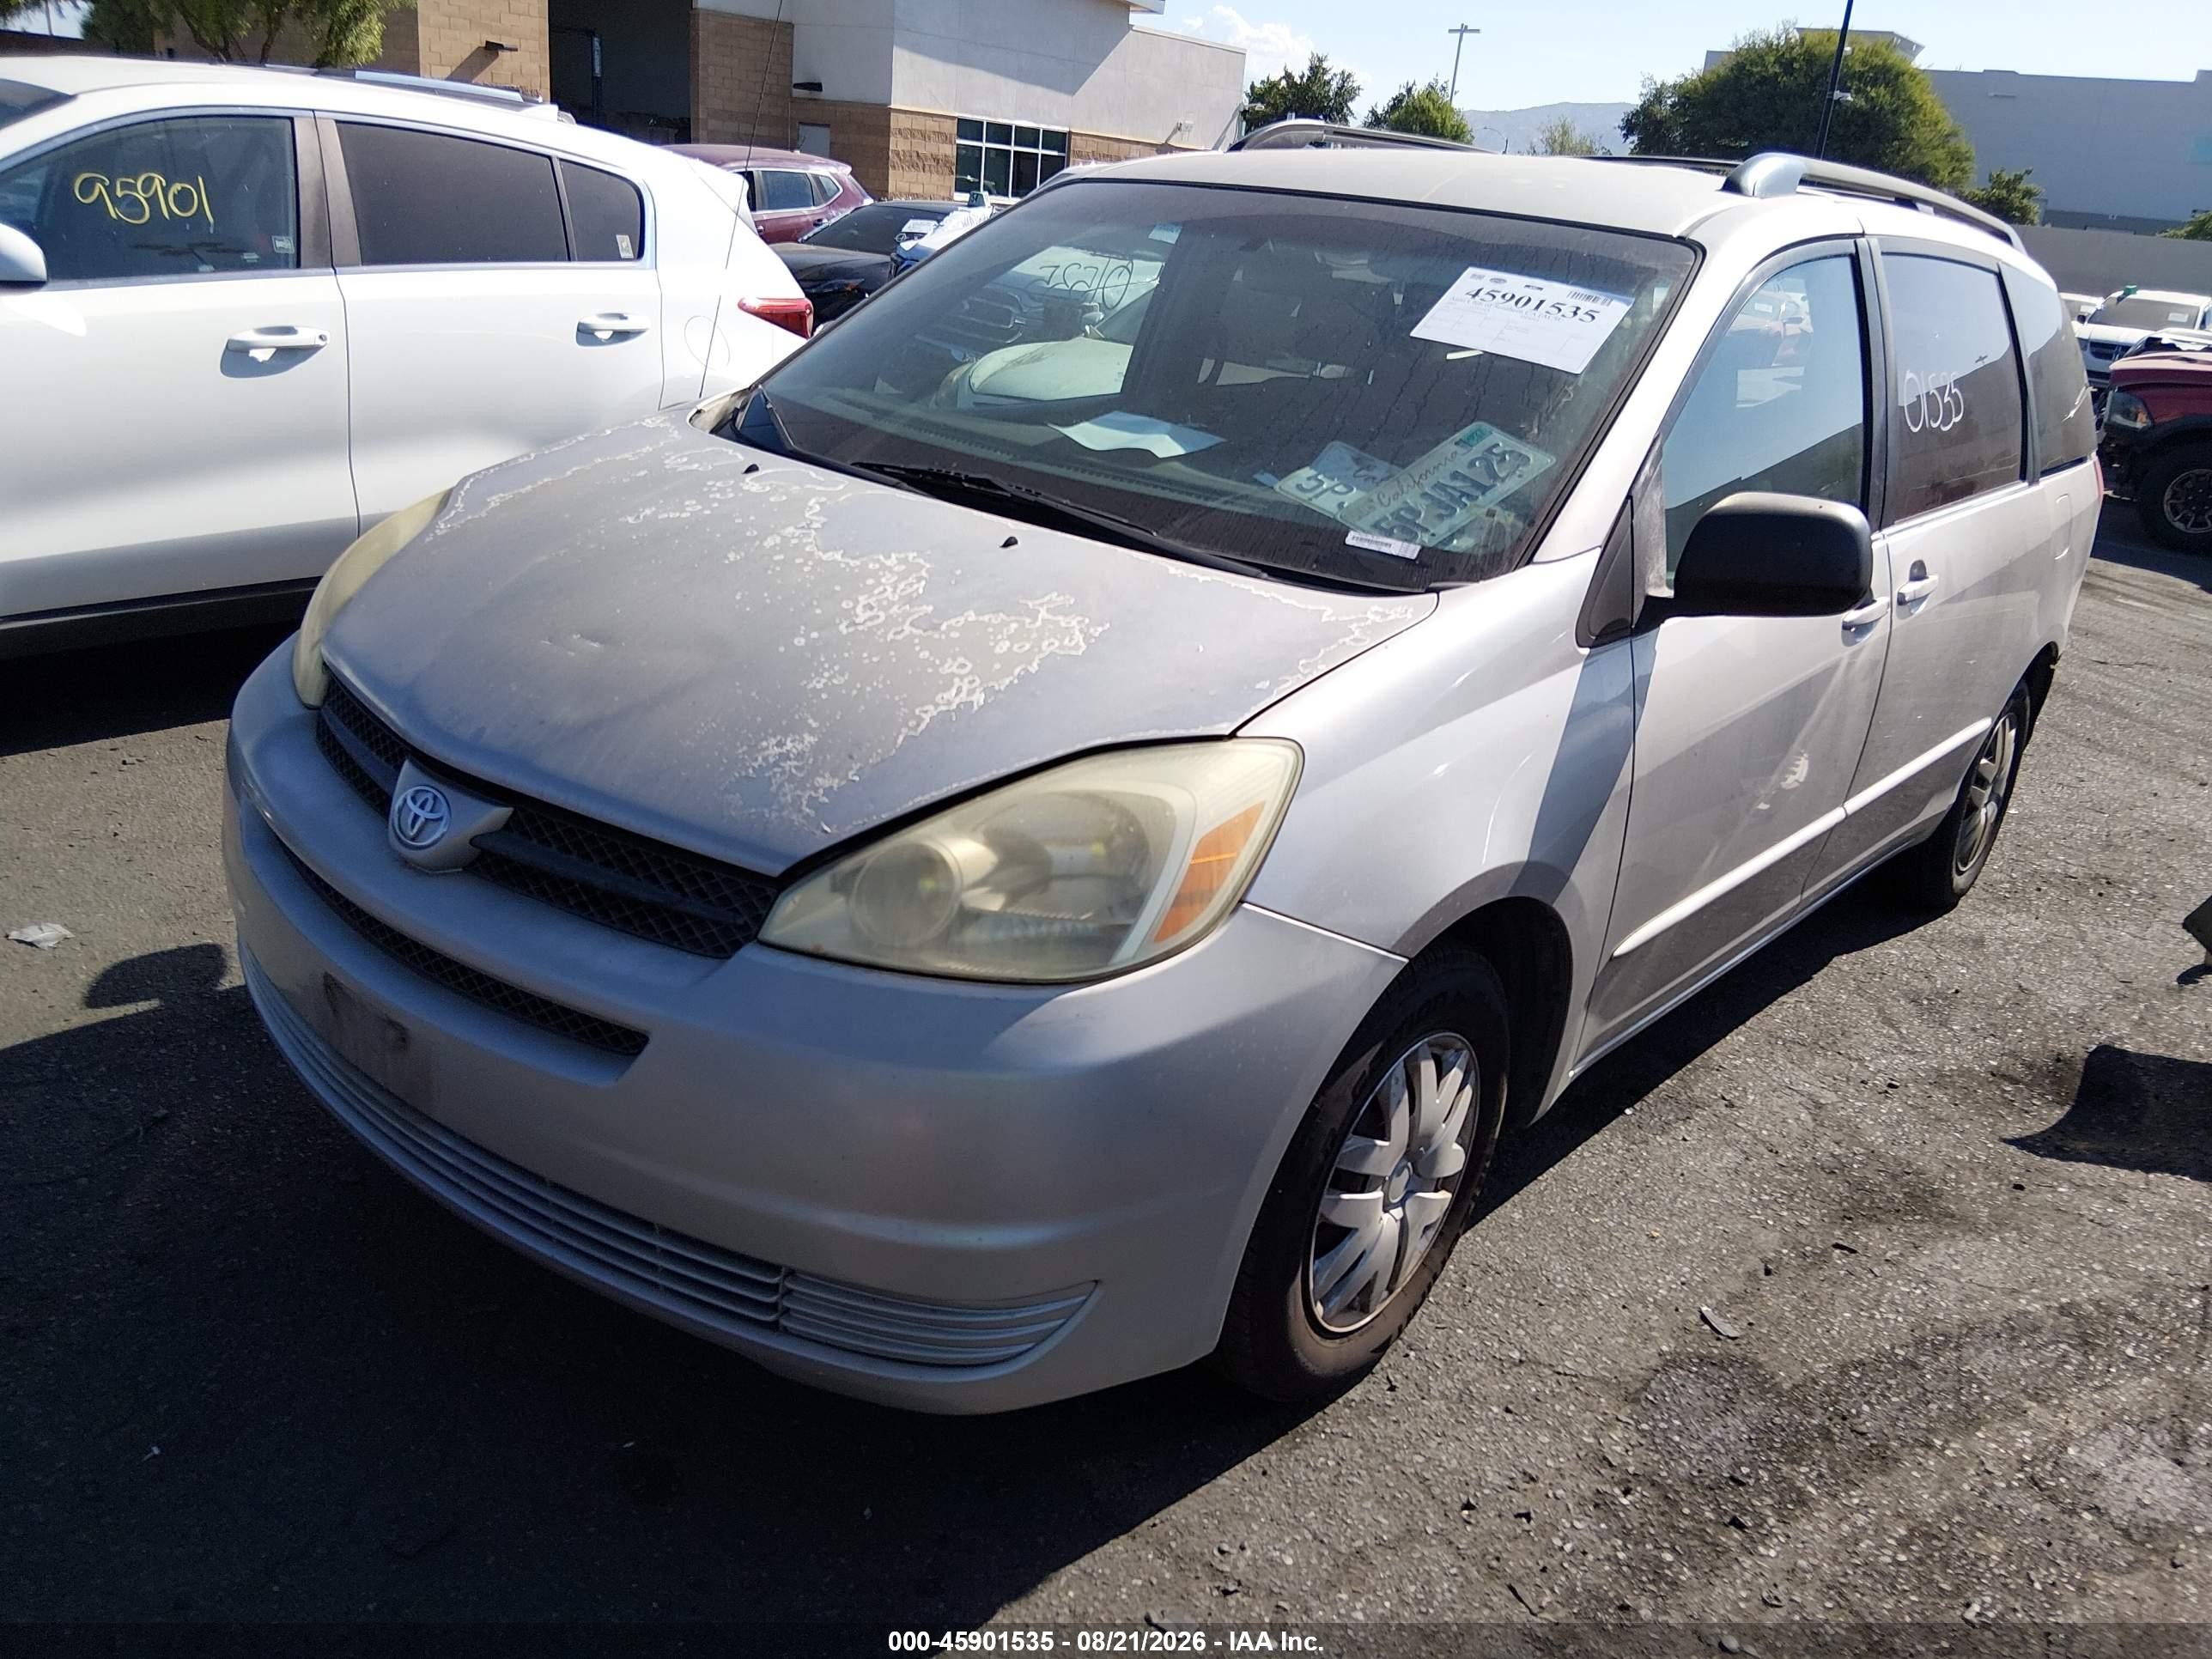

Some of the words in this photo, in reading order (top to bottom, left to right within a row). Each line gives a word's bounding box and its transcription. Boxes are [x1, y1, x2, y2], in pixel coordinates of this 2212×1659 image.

[74, 172, 215, 228] 95901
[1465, 286, 1601, 324] 45901535
[1903, 369, 1965, 433] 01535
[1376, 448, 1459, 507] California
